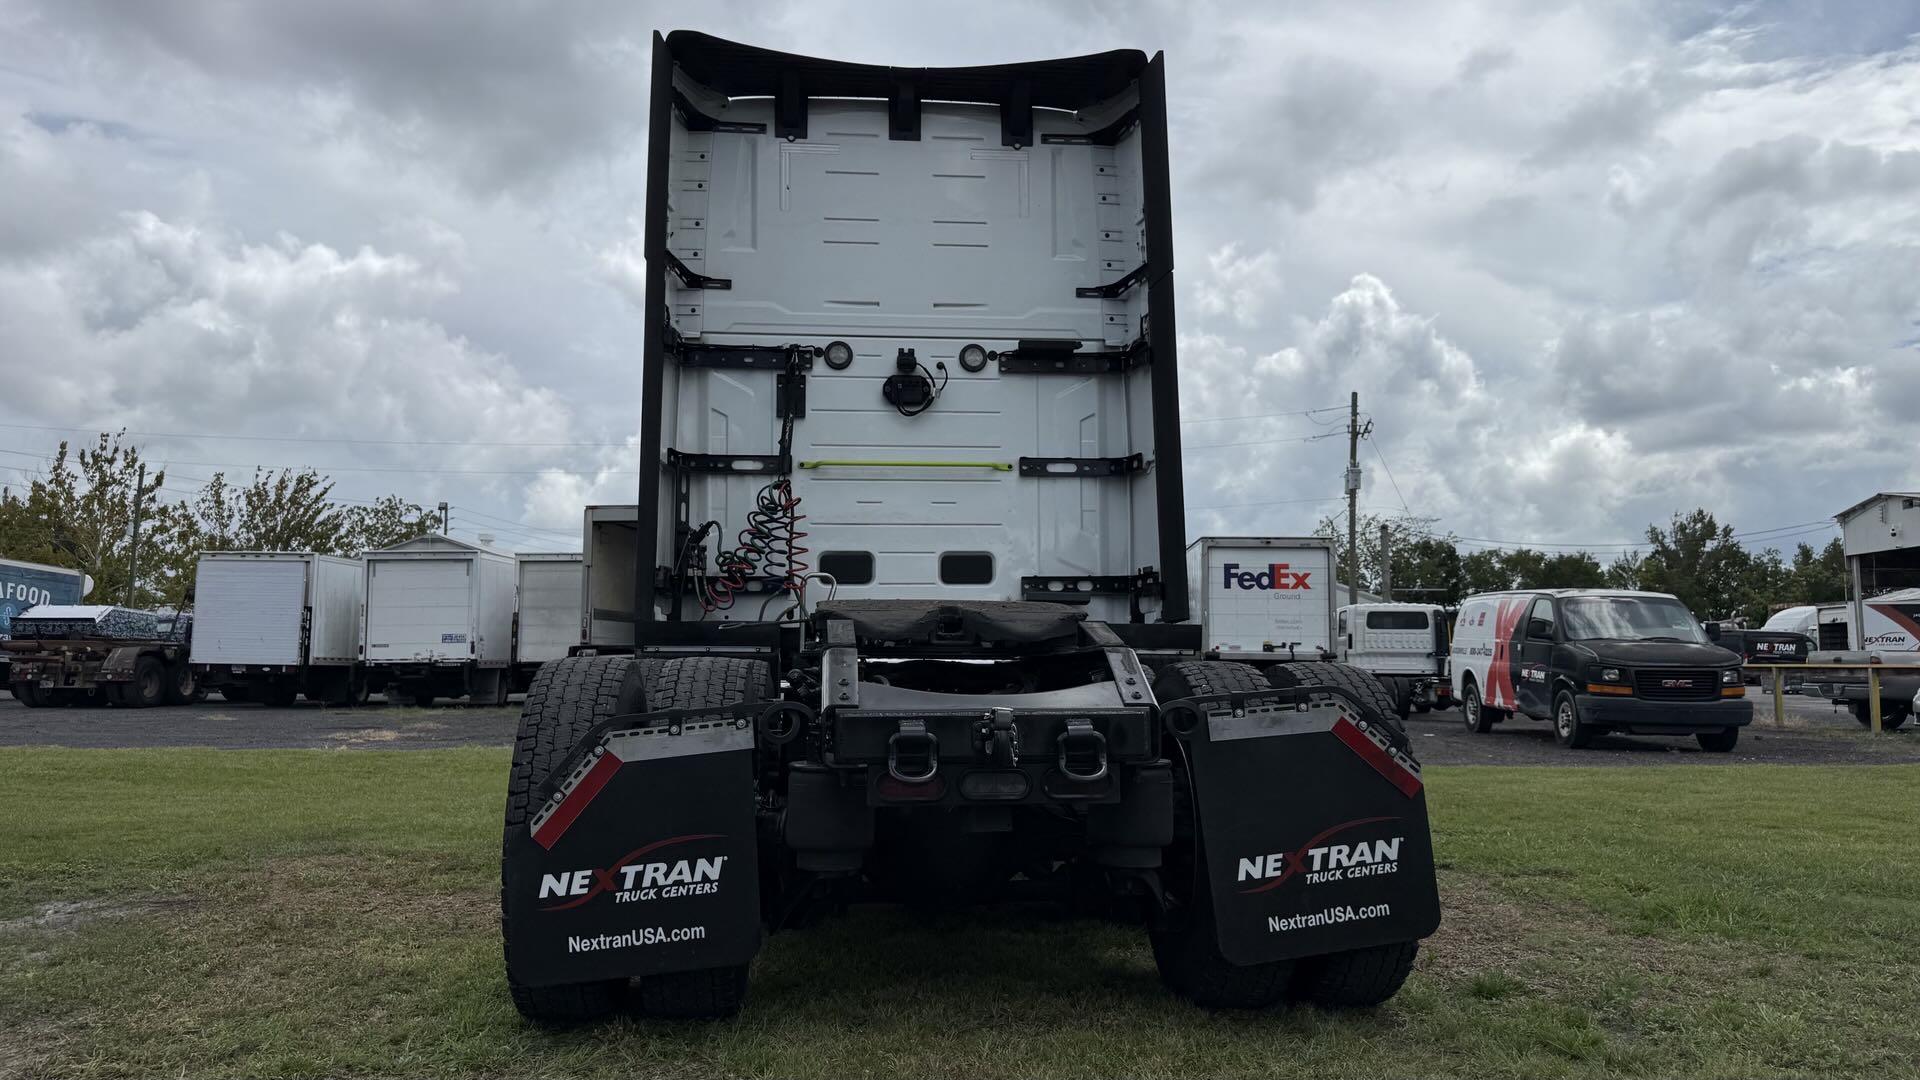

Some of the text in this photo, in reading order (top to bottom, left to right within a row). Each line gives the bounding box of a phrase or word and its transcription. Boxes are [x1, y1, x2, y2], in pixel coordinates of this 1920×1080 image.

[1223, 563, 1312, 590] FedEx
[1273, 592, 1301, 600] Ground
[1661, 679, 1693, 688] GMC
[1237, 837, 1401, 882] NEXTRAN
[538, 855, 724, 899] NEXTRAN
[1305, 862, 1399, 885] TRUCK CENTERS
[615, 882, 719, 903] TRUCK CENTERS
[1268, 903, 1391, 933] NextranUSA.com
[568, 925, 706, 953] NextranUSA.com
